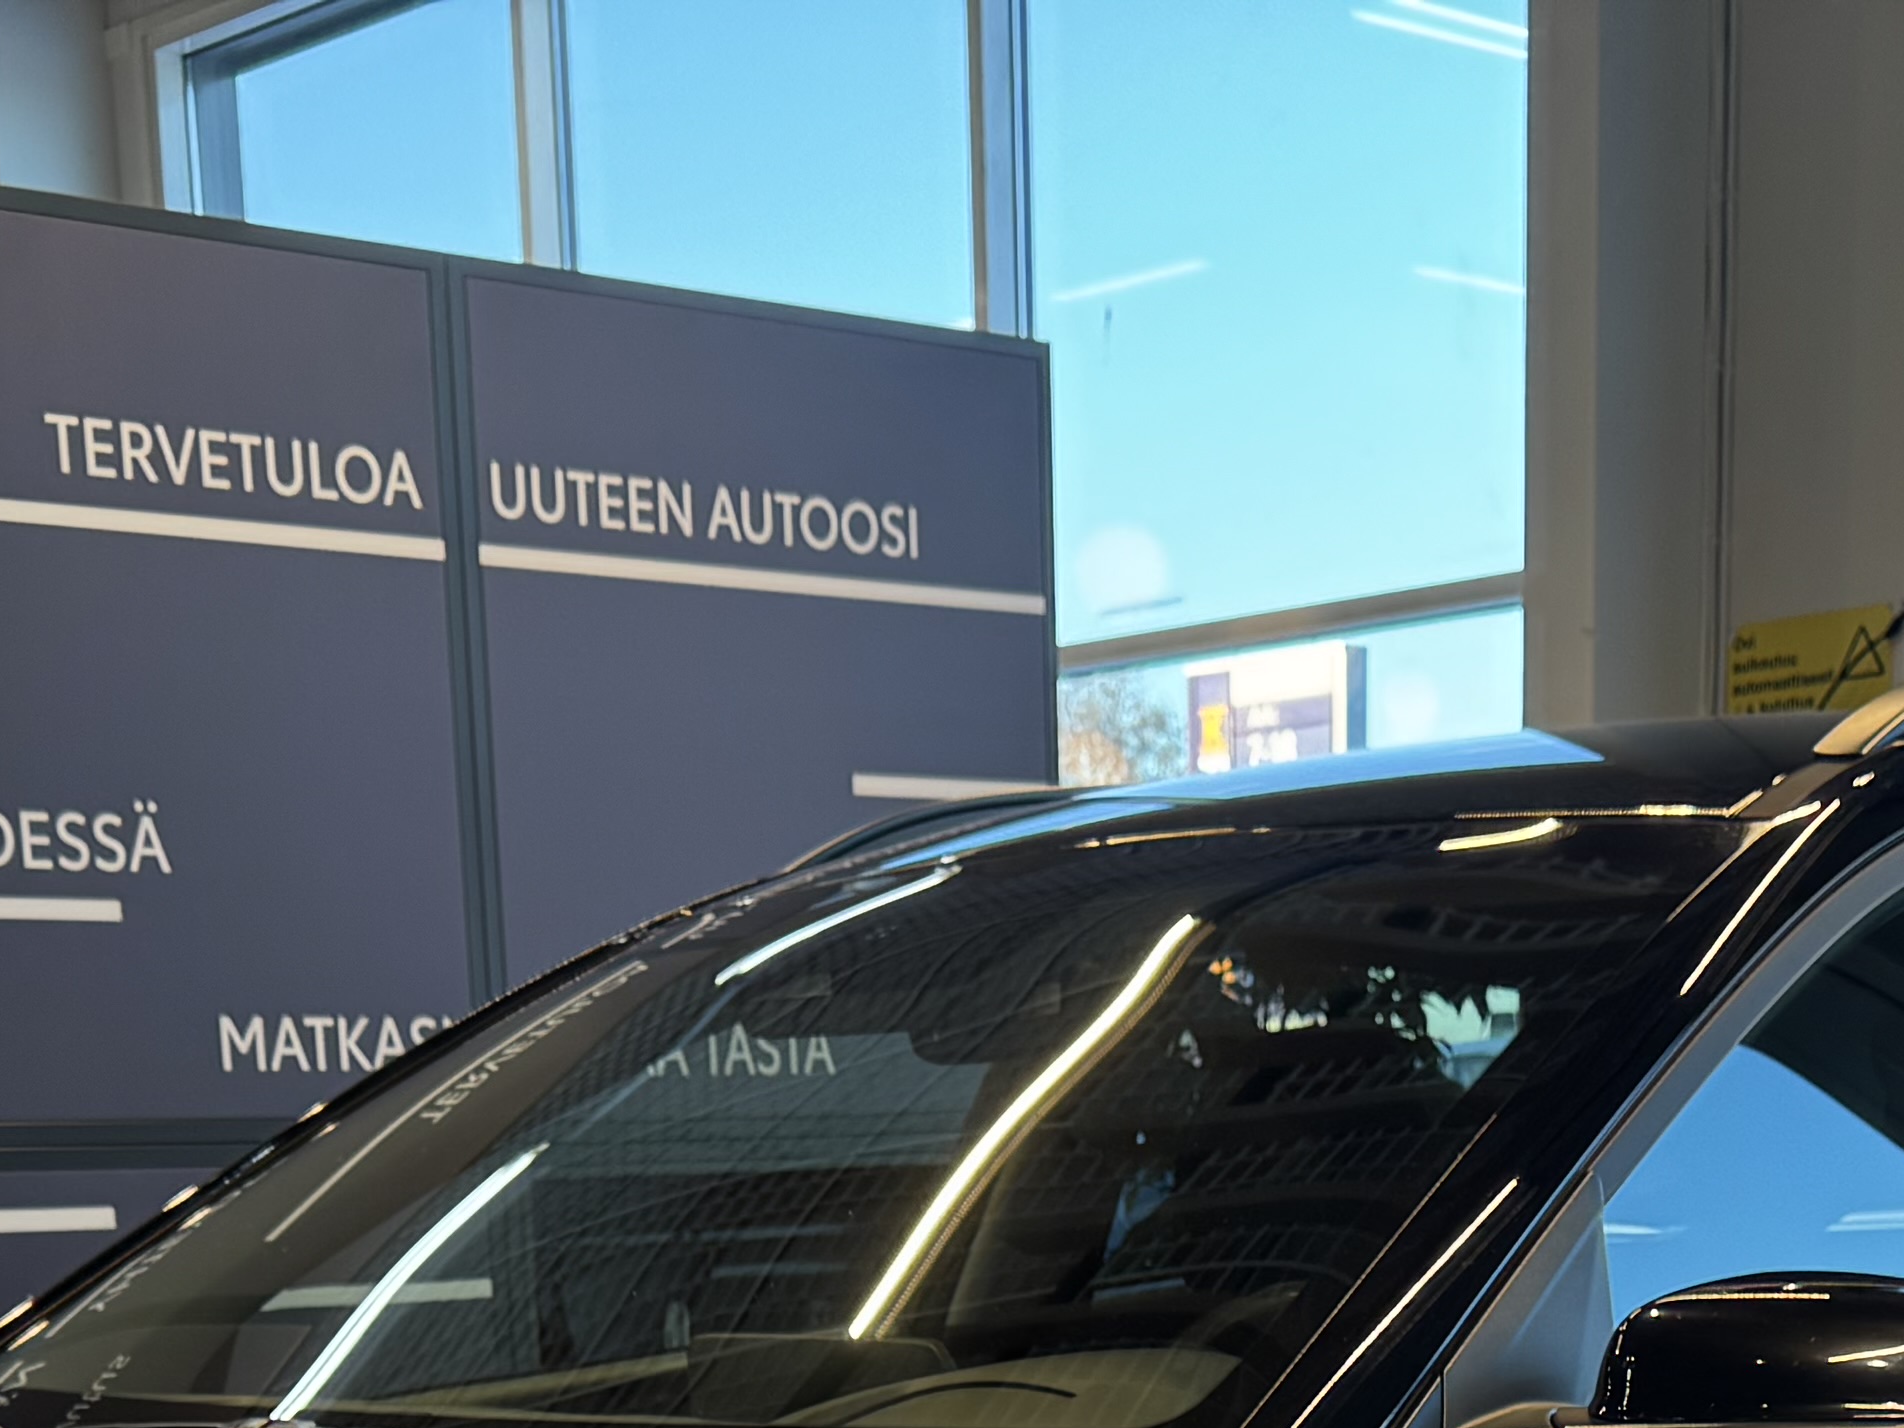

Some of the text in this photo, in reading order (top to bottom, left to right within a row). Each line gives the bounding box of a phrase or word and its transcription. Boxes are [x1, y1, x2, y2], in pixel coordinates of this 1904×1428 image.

[44, 411, 920, 559] TERVETULOA UUTEEN AUTOOSI
[218, 1013, 462, 1072] MATKAS
